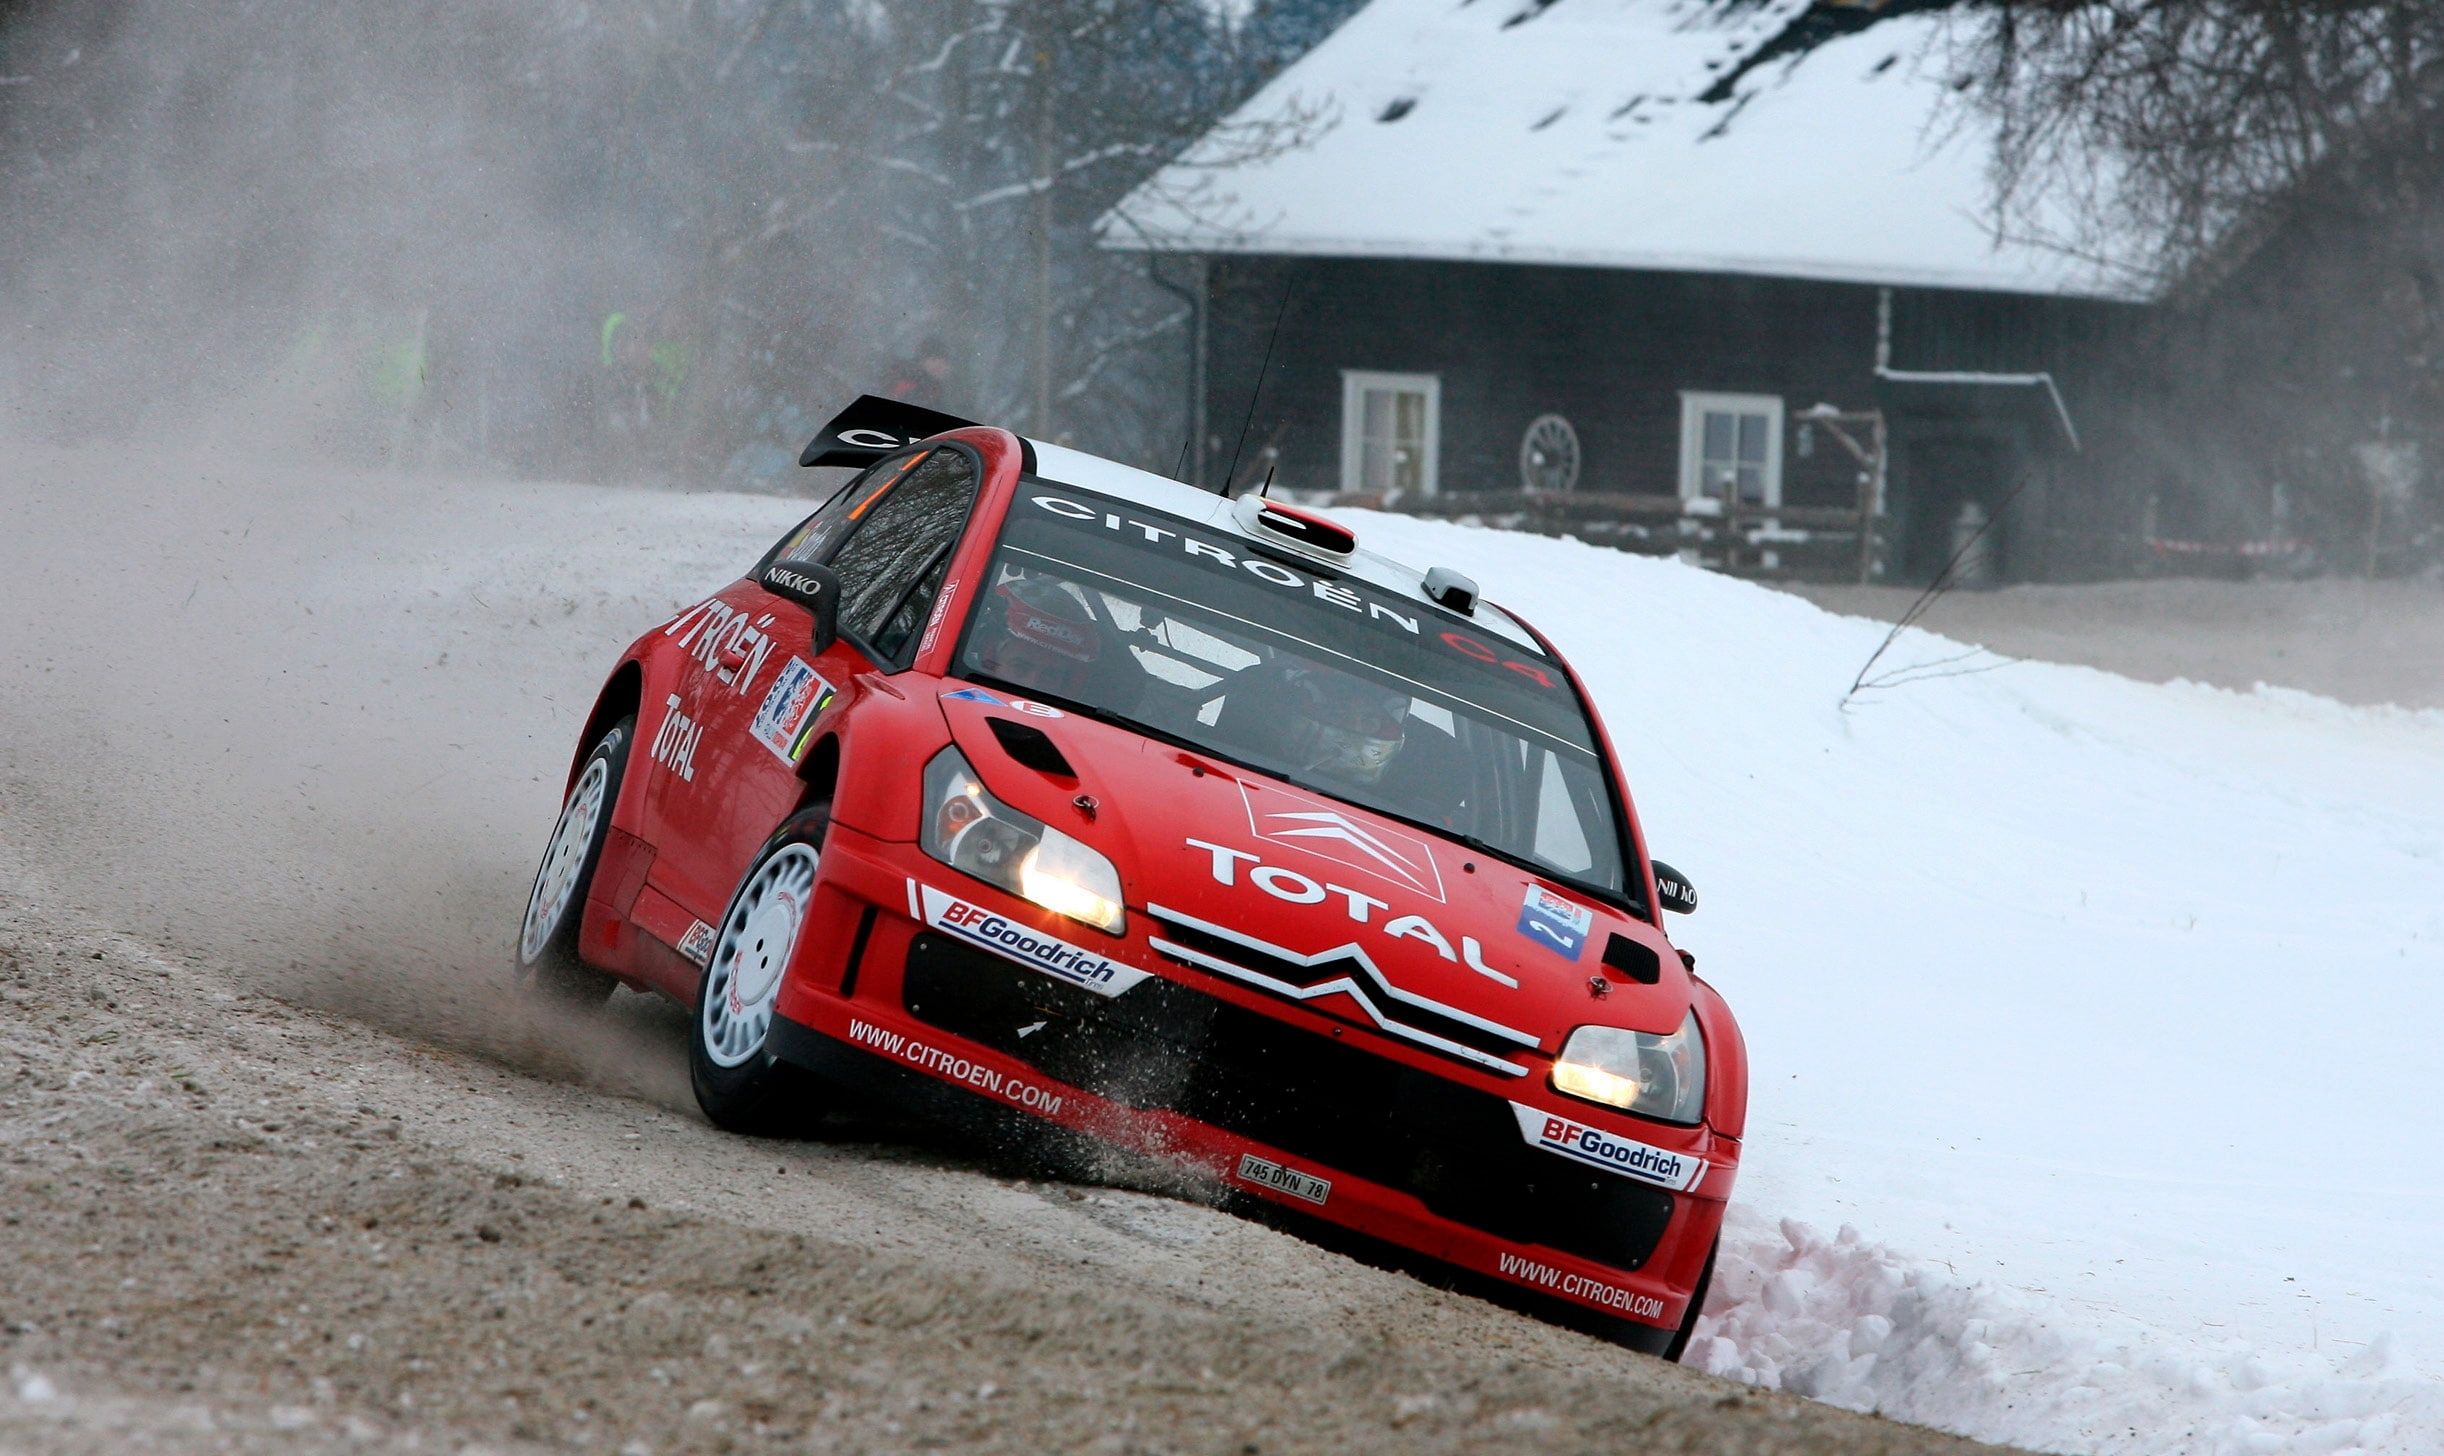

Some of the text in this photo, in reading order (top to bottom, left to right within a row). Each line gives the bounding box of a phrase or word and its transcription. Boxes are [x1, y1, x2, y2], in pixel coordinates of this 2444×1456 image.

[764, 567, 821, 595] NIKKO
[1031, 495, 1557, 689] CITROËN C4
[655, 598, 777, 696] ITROËN
[651, 693, 703, 782] TOTAL
[942, 901, 1115, 984] BFGoodrich
[1185, 837, 1520, 990] TOTAL
[1529, 920, 1574, 949] 2
[849, 1018, 1063, 1115] WWW.CITROEN.COM
[1244, 1160, 1324, 1198] 745 DYN 78
[1541, 1117, 1682, 1178] BFGoodrich
[1499, 1252, 1664, 1319] WWW.CITROEN.COM
